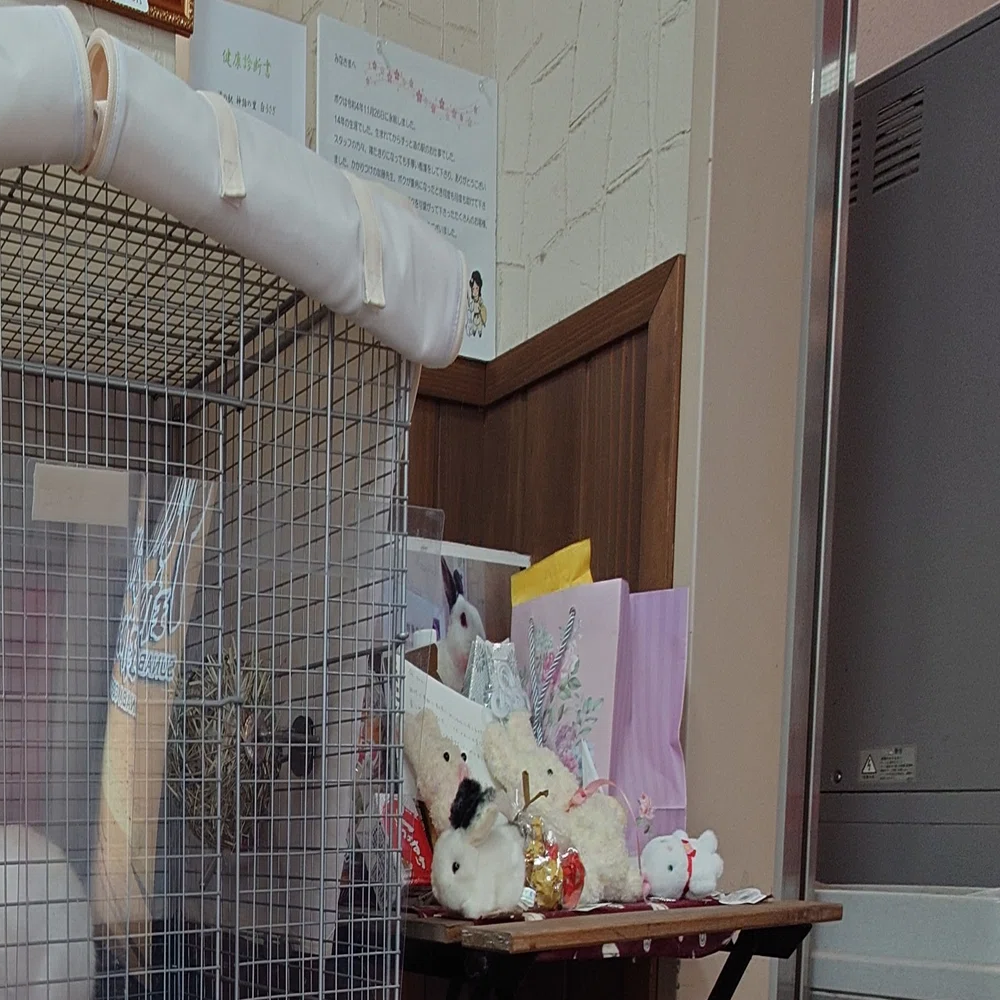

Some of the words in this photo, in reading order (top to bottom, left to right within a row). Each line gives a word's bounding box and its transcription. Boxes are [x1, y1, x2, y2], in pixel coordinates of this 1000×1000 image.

[222, 48, 272, 80] 健康診断書
